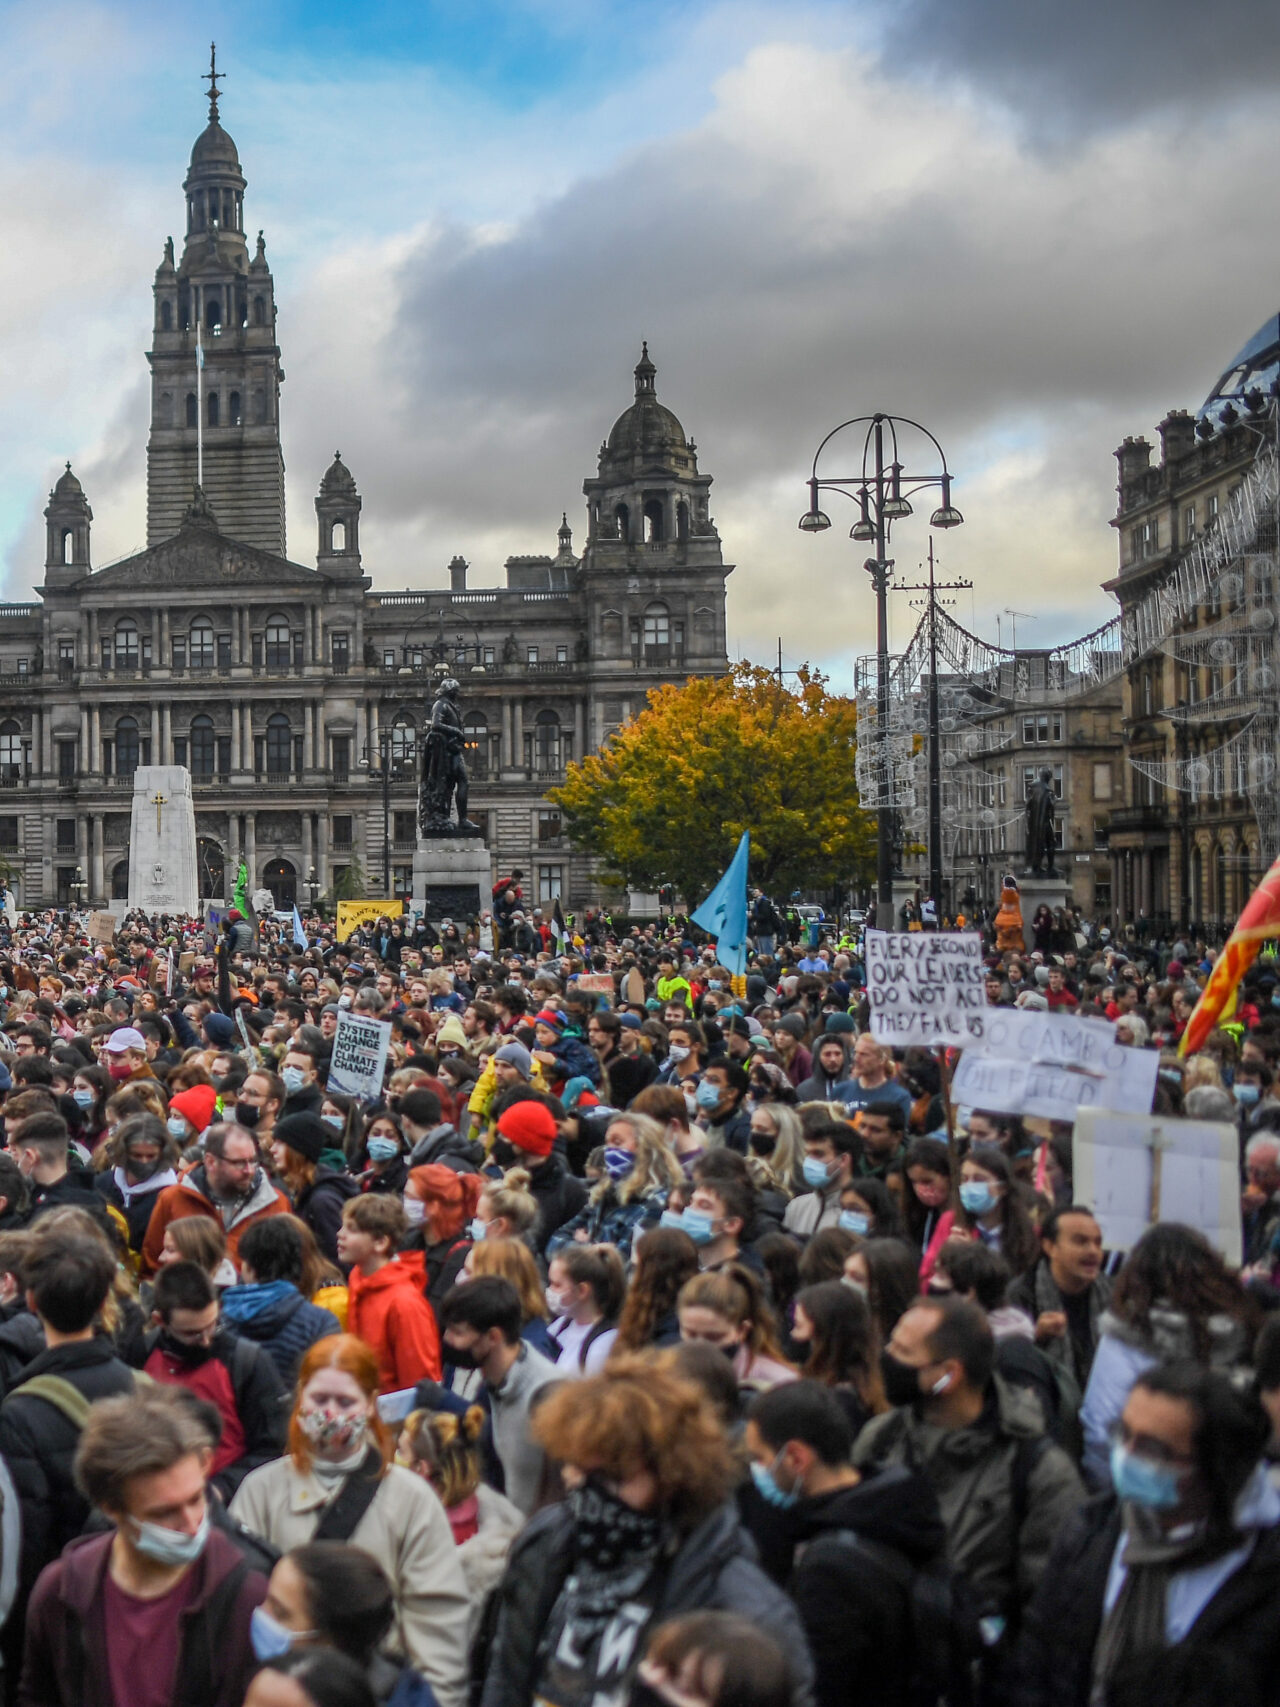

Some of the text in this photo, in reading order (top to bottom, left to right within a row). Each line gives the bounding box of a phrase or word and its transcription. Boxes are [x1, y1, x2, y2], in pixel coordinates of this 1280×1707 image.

[870, 936, 978, 960] EVERY SECOND
[872, 957, 982, 984] OUR LEADERS
[872, 986, 983, 1009] DO NOT ACT
[339, 1022, 380, 1040] SYSTEM
[875, 1012, 984, 1037] THEY FAIL US
[336, 1041, 357, 1053] NOT
[338, 1031, 380, 1050] CHANGE
[333, 1059, 376, 1076] CHANGE
[335, 1050, 378, 1069] CLIMATE
